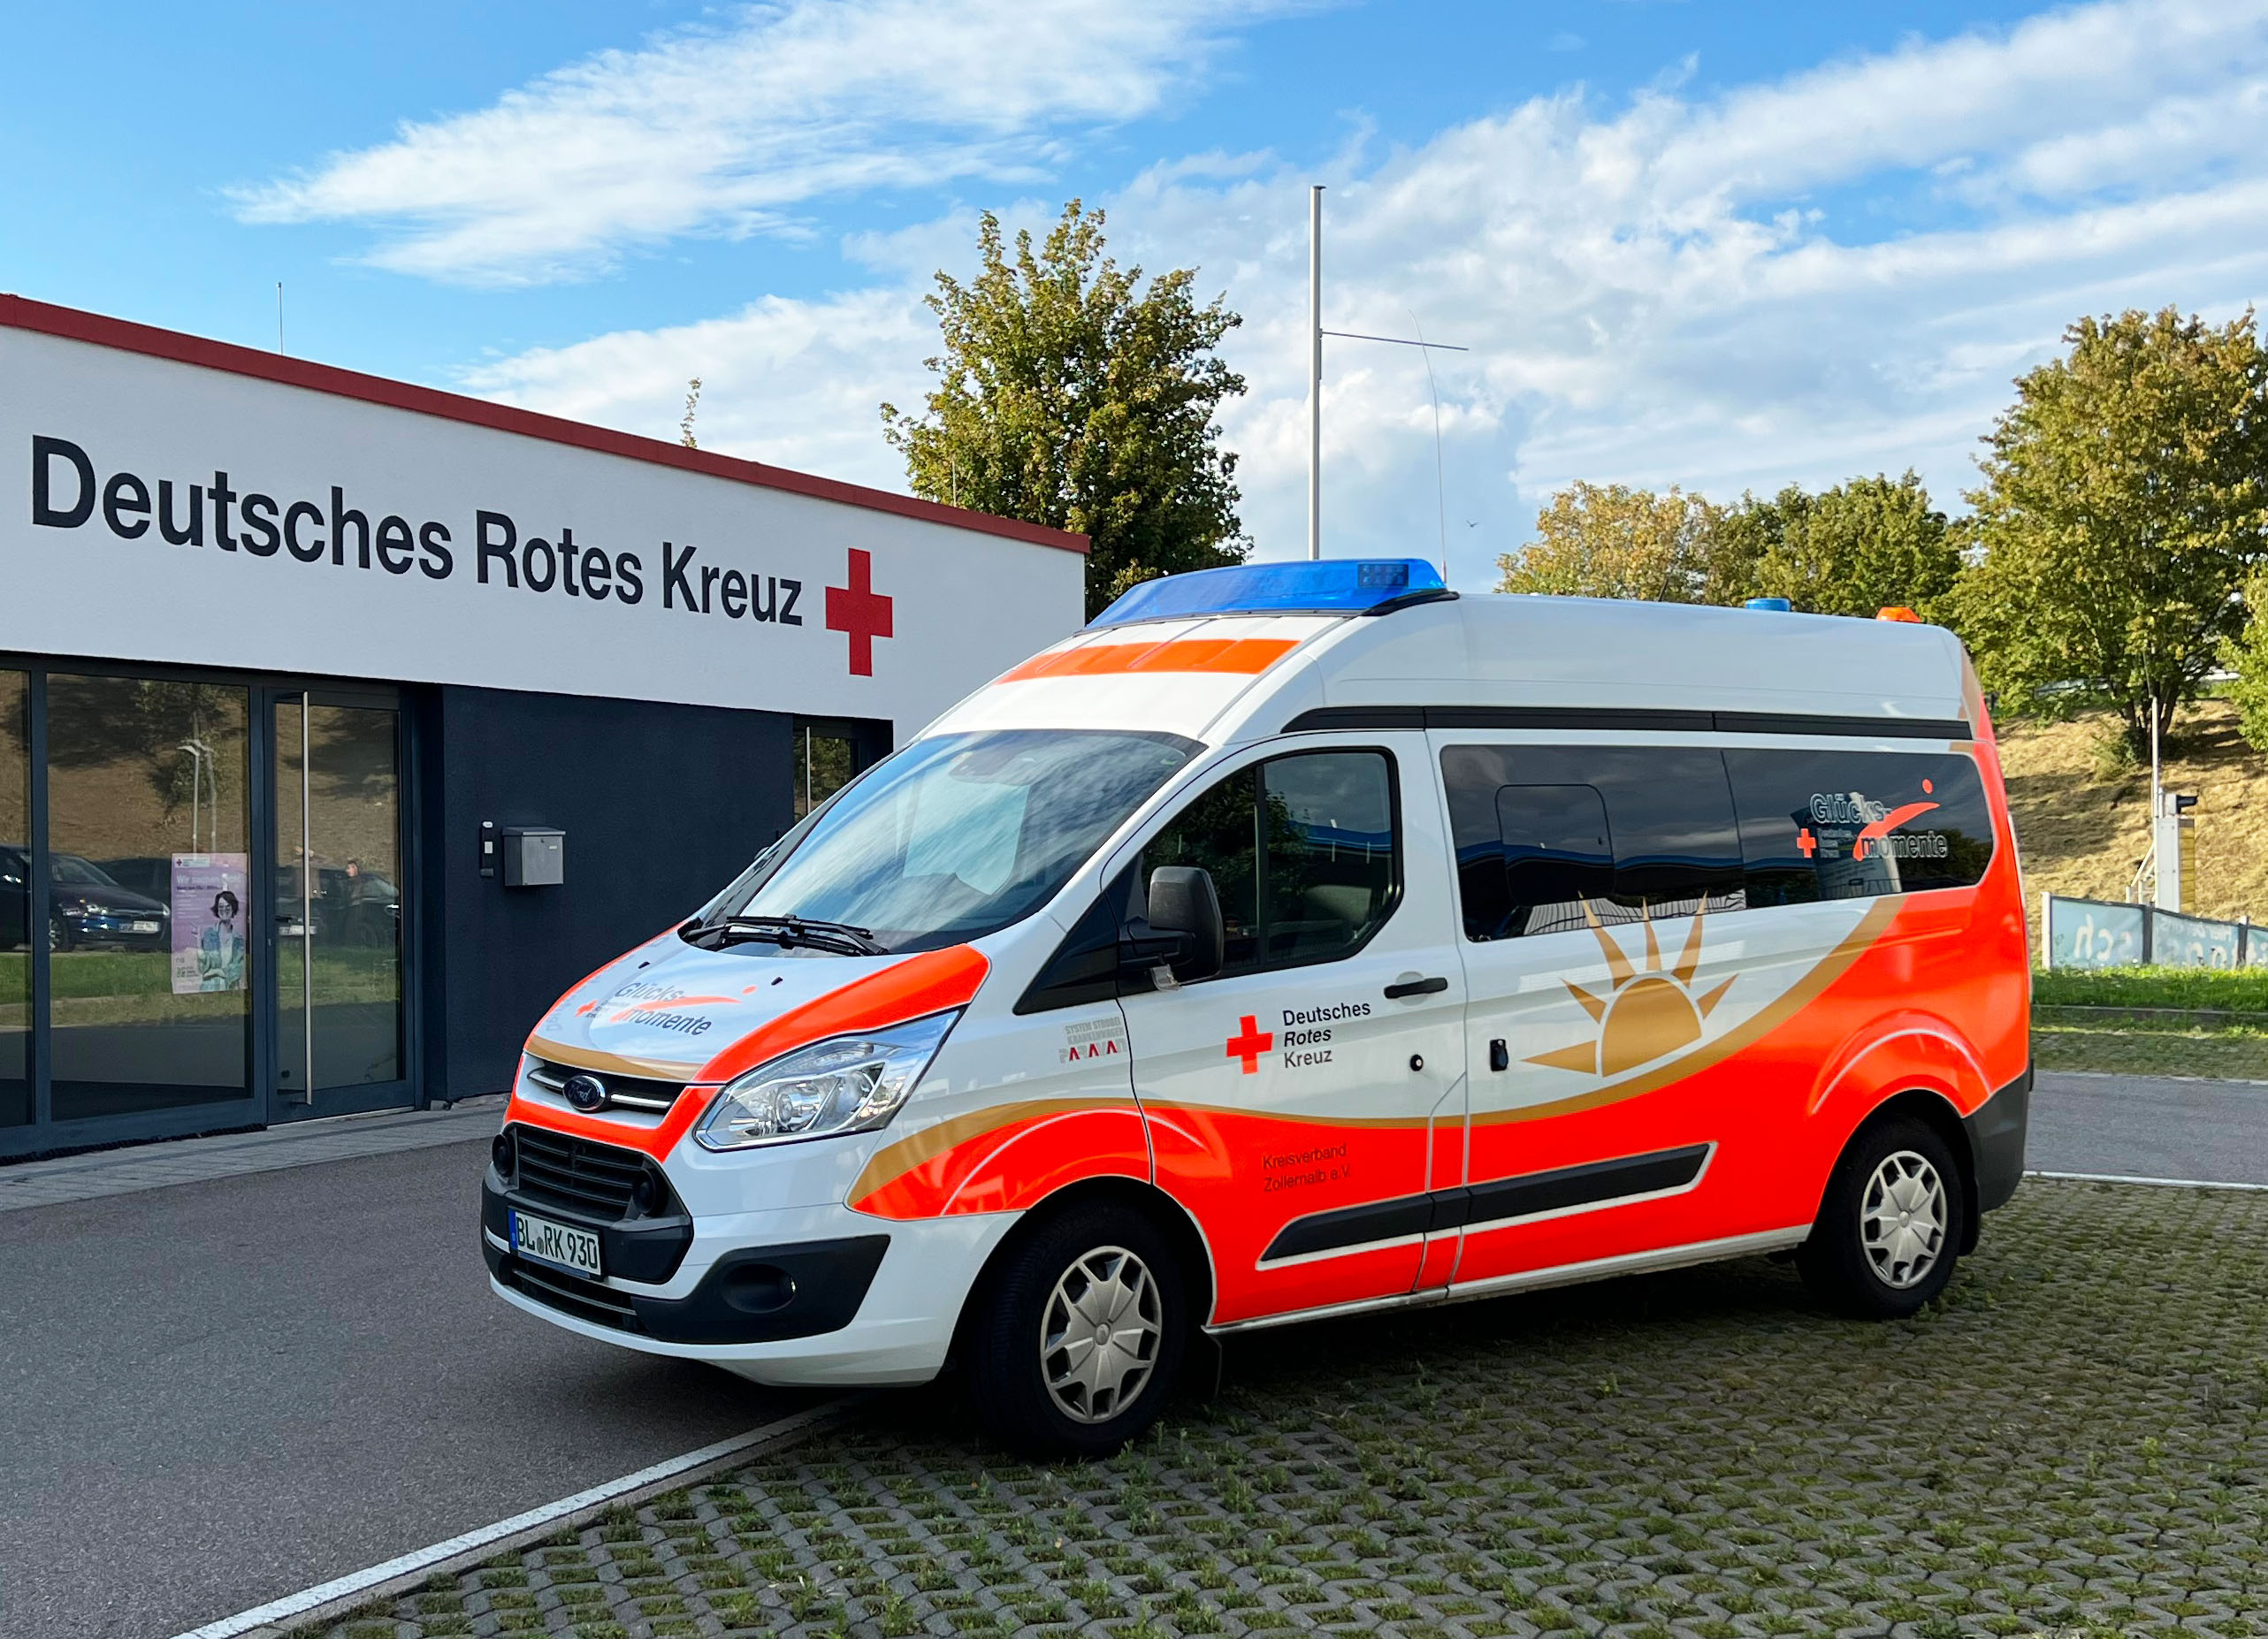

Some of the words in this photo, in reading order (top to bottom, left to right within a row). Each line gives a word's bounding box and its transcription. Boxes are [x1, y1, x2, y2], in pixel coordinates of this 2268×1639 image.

[32, 434, 454, 580] Deutsches
[476, 509, 644, 605] Rotes
[662, 541, 803, 626] Kreuz
[1860, 830, 1949, 858] momente
[622, 1007, 712, 1036] momente
[1282, 1001, 1371, 1026] Deutsches
[1284, 1026, 1332, 1048] Rotes
[1284, 1048, 1333, 1068] Kreuz
[1263, 1142, 1347, 1170] Kreisverband
[1264, 1168, 1326, 1192] Zollernalb
[515, 1216, 535, 1251] BL
[544, 1225, 565, 1260] RK
[567, 1232, 598, 1269] 930
